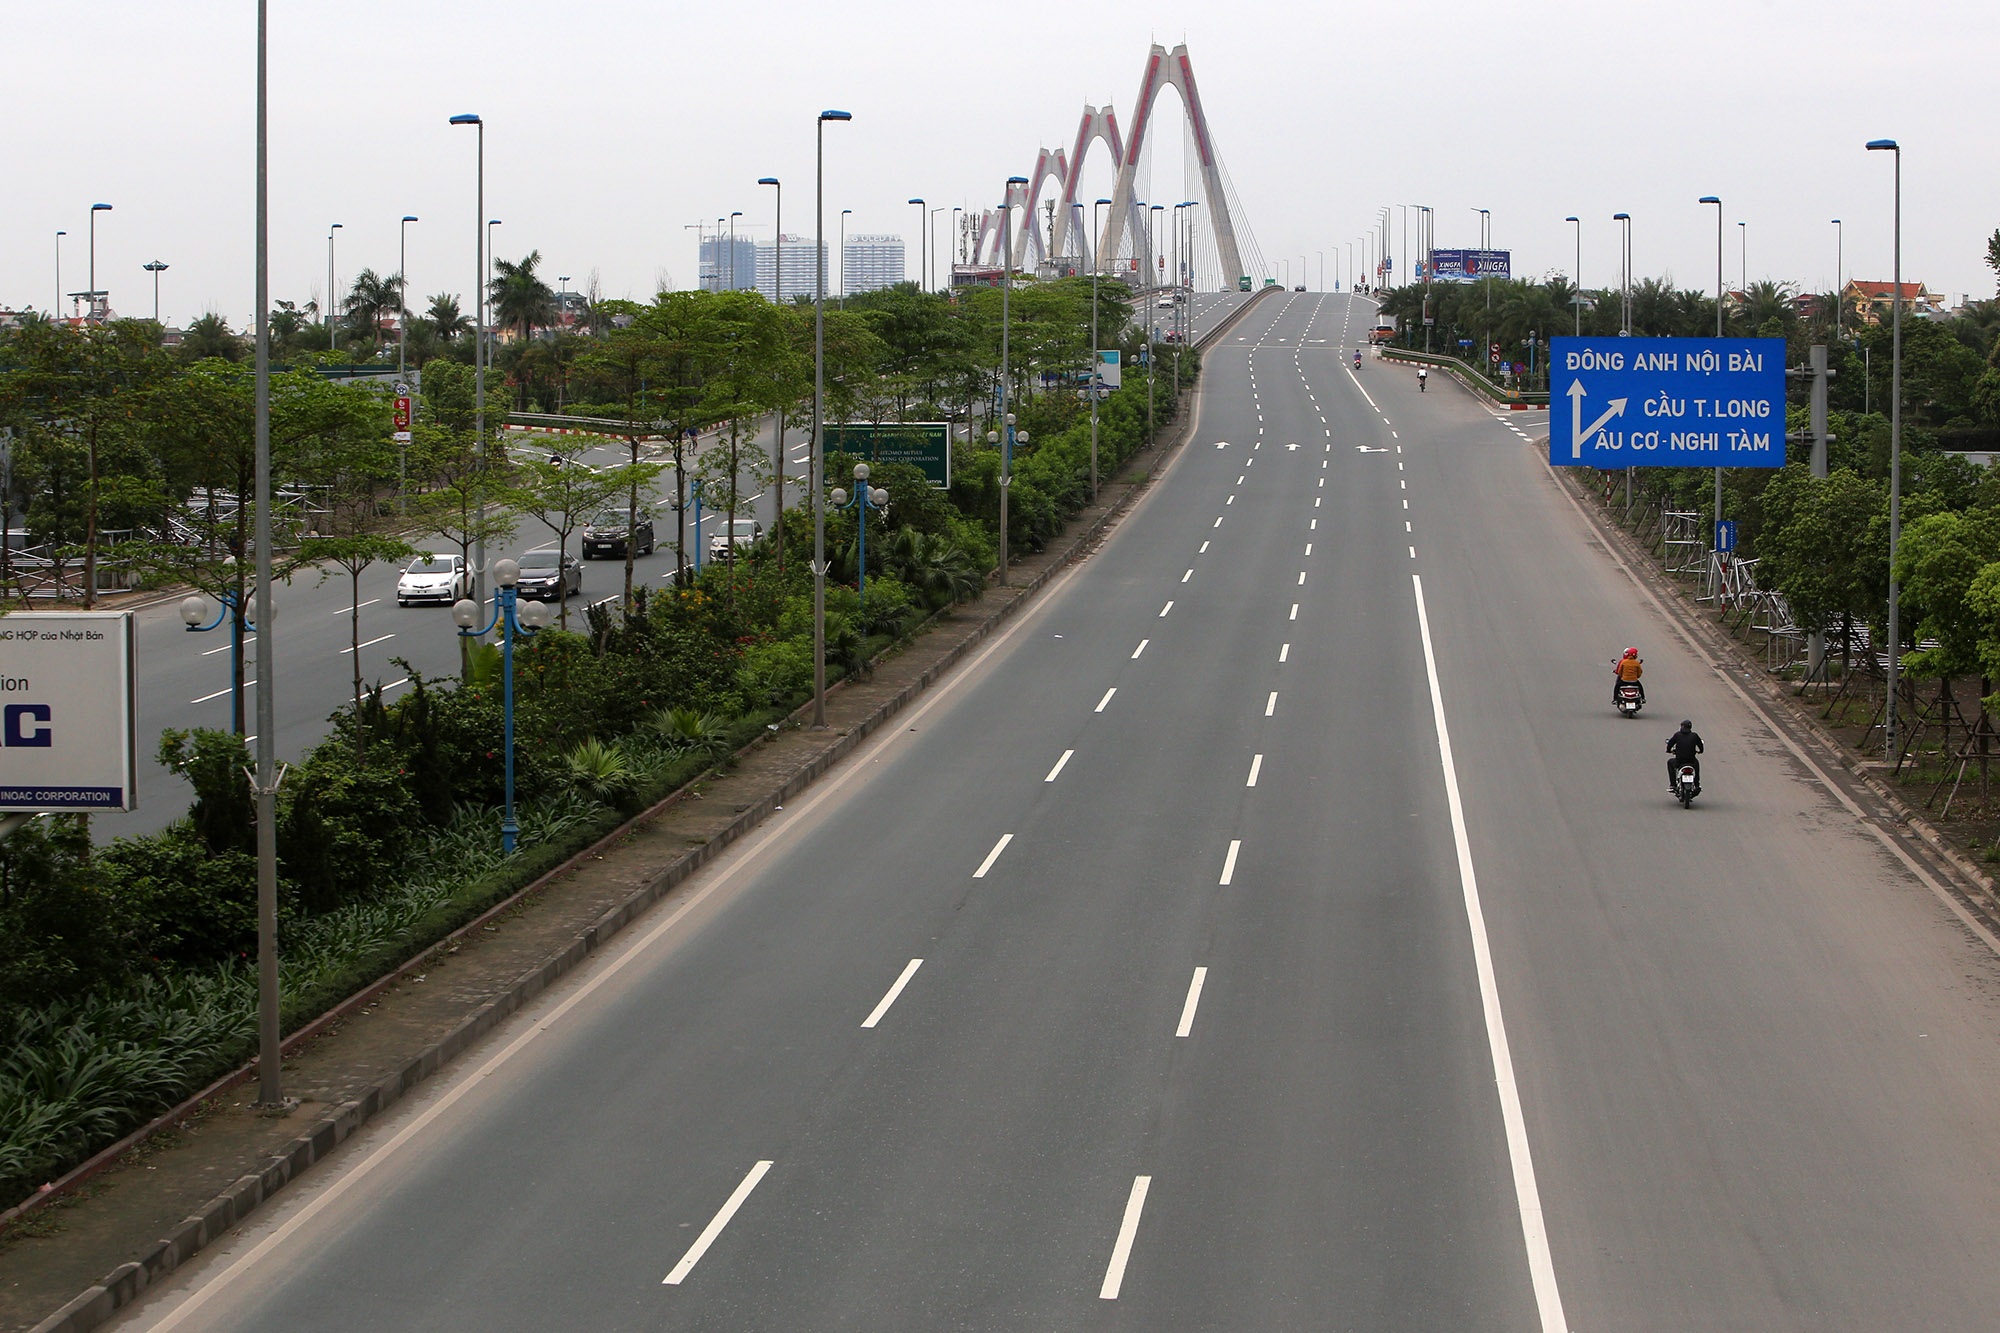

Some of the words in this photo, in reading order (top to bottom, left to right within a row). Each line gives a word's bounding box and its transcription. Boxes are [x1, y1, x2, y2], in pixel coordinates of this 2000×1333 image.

[1566, 348, 1625, 371] ĐÔNG
[1632, 353, 1678, 371] ANH
[1686, 349, 1720, 376] NỘI
[1728, 349, 1763, 372] BÀI
[1644, 389, 1686, 417] CẦU
[1693, 399, 1770, 418] T.LONG
[1594, 427, 1623, 450] ÂU
[1726, 428, 1770, 451] TÀM
[16, 629, 39, 642] HỢP
[60, 629, 84, 642] Nhật
[1, 675, 29, 691] ion
[0, 791, 33, 801] INOAC
[35, 791, 111, 801] CORPORATION
